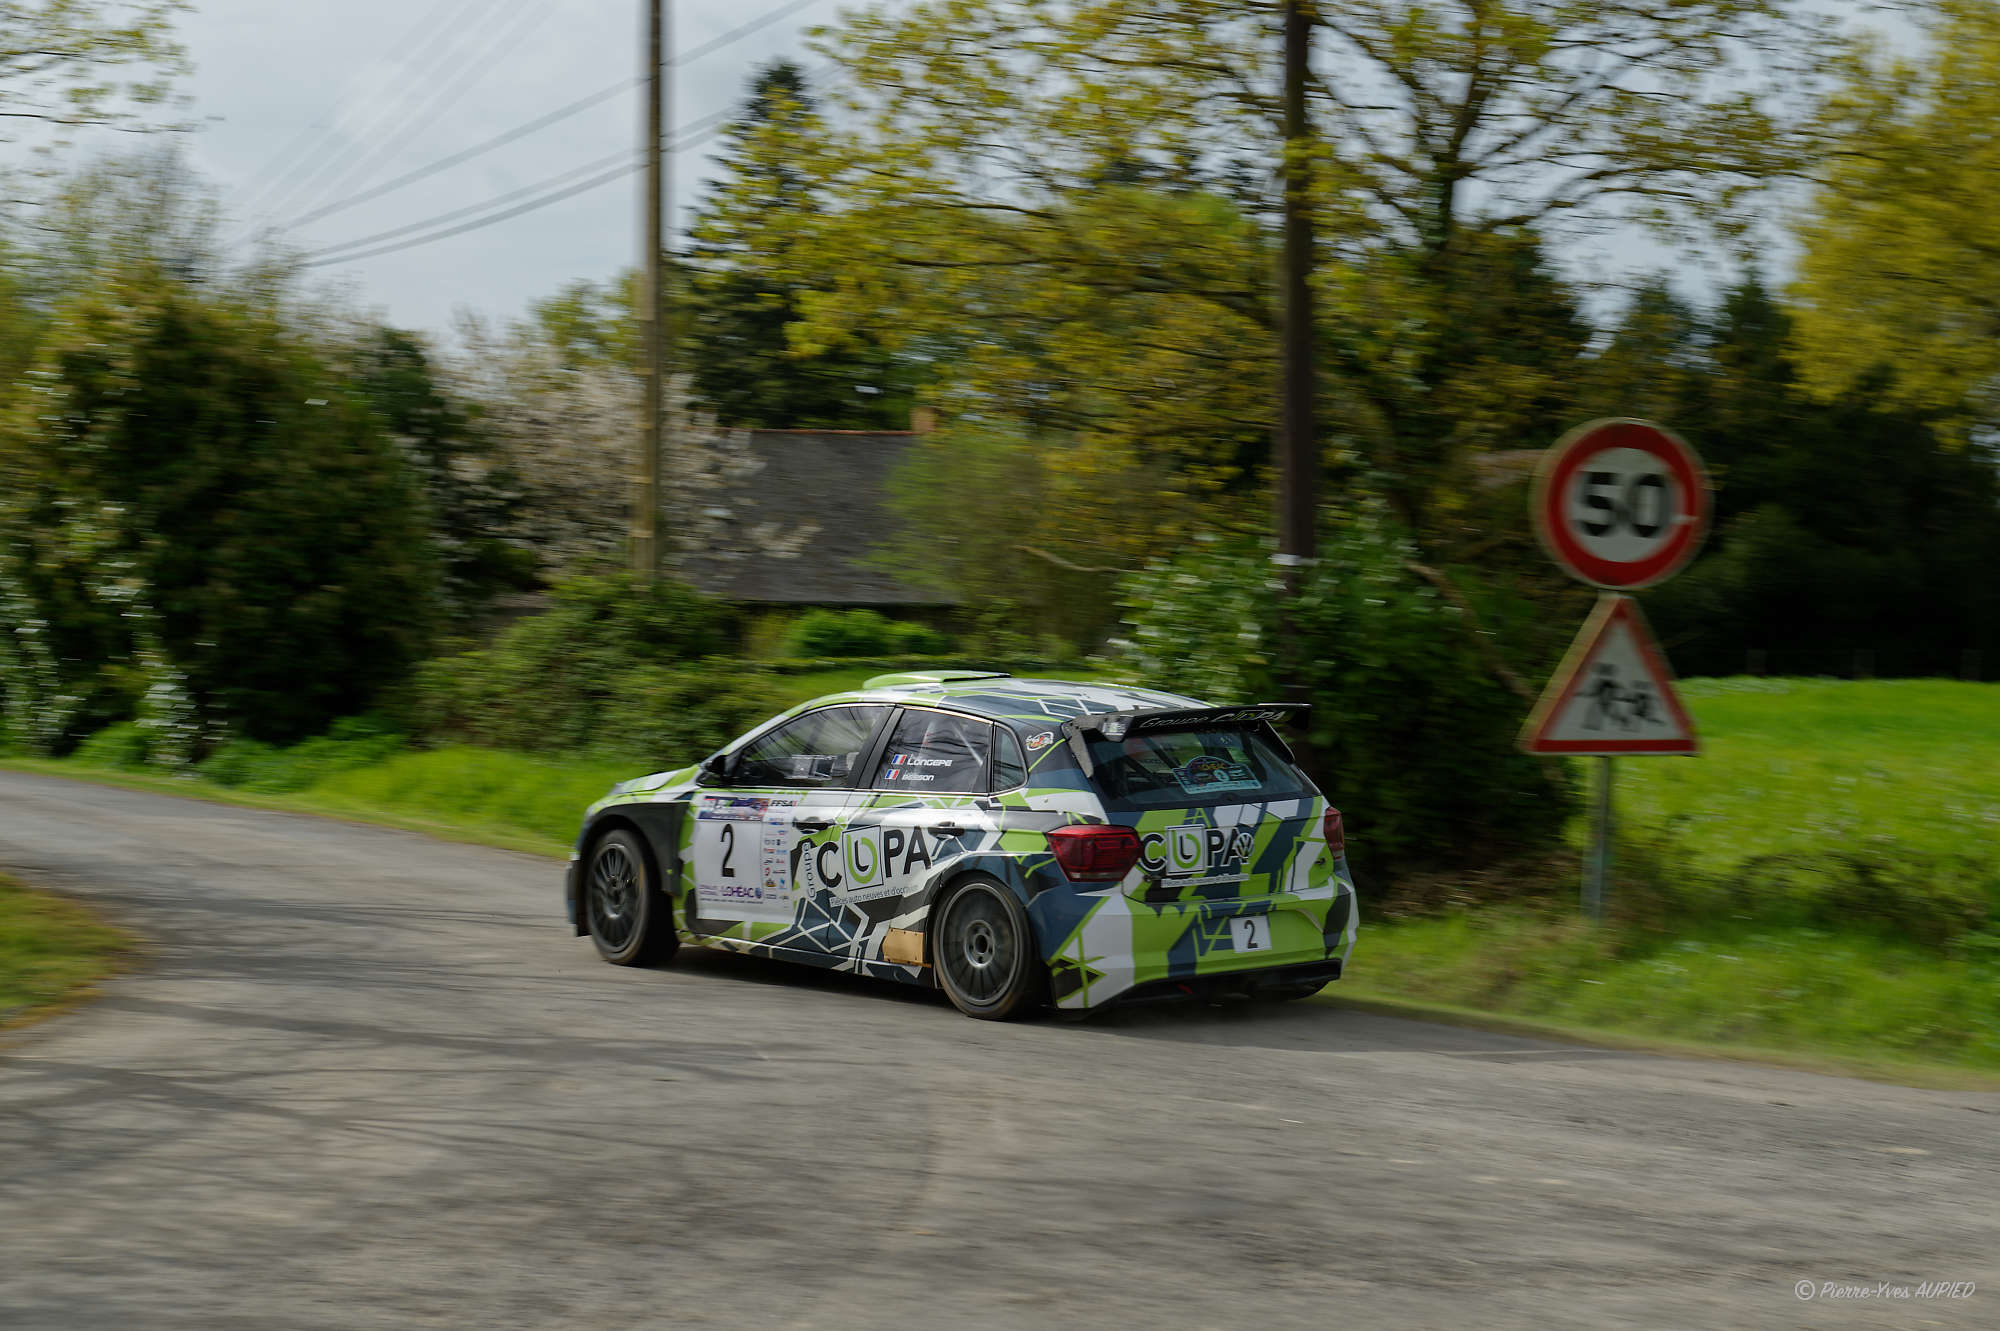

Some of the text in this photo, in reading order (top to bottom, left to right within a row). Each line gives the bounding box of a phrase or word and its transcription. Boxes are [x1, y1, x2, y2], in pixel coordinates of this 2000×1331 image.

[1580, 472, 1671, 537] 50
[720, 823, 735, 877] 2
[802, 842, 817, 899] Groupe
[1244, 920, 1258, 949] 2
